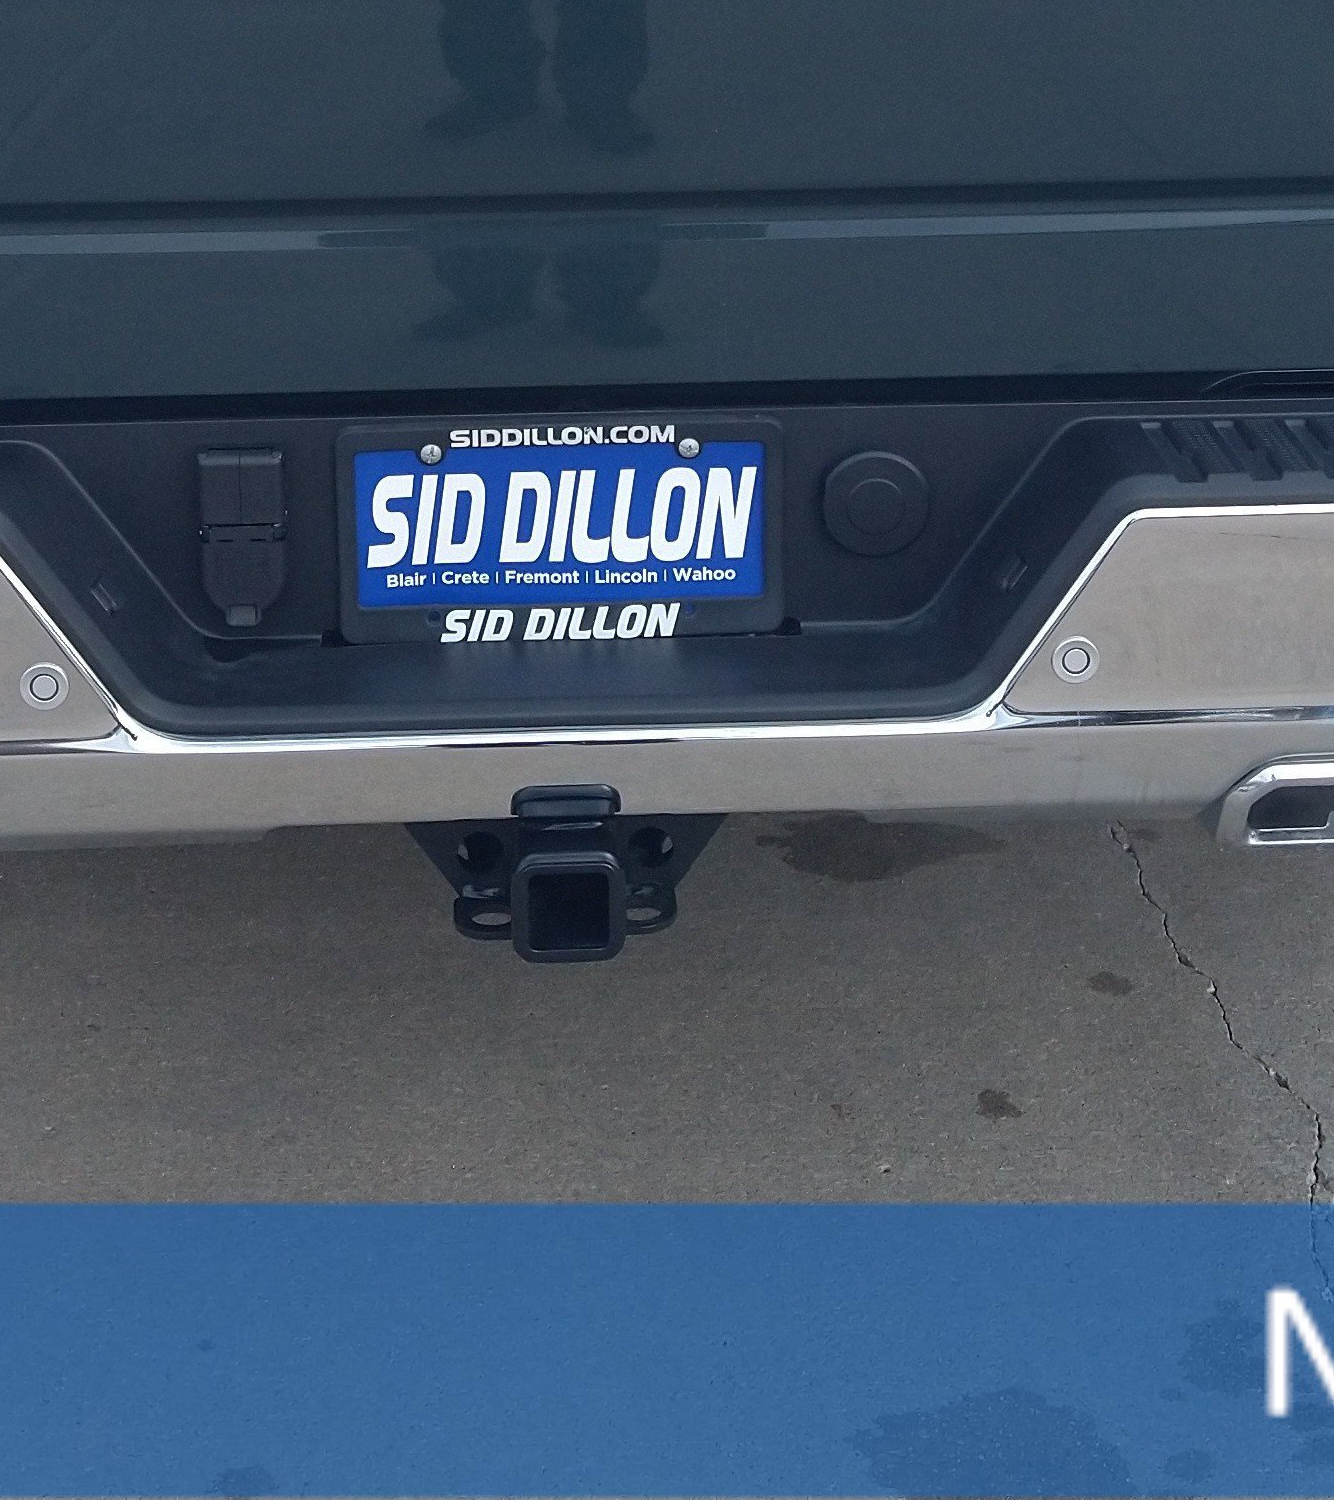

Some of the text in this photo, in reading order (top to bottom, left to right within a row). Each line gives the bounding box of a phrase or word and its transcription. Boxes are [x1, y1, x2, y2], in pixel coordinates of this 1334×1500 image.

[449, 424, 675, 449] SIDDILLON.COM
[367, 466, 758, 569] SID DILLON
[386, 566, 737, 589] Blair Crete Fremont Lincoln Wahoo
[440, 602, 681, 643] SID DILLON
